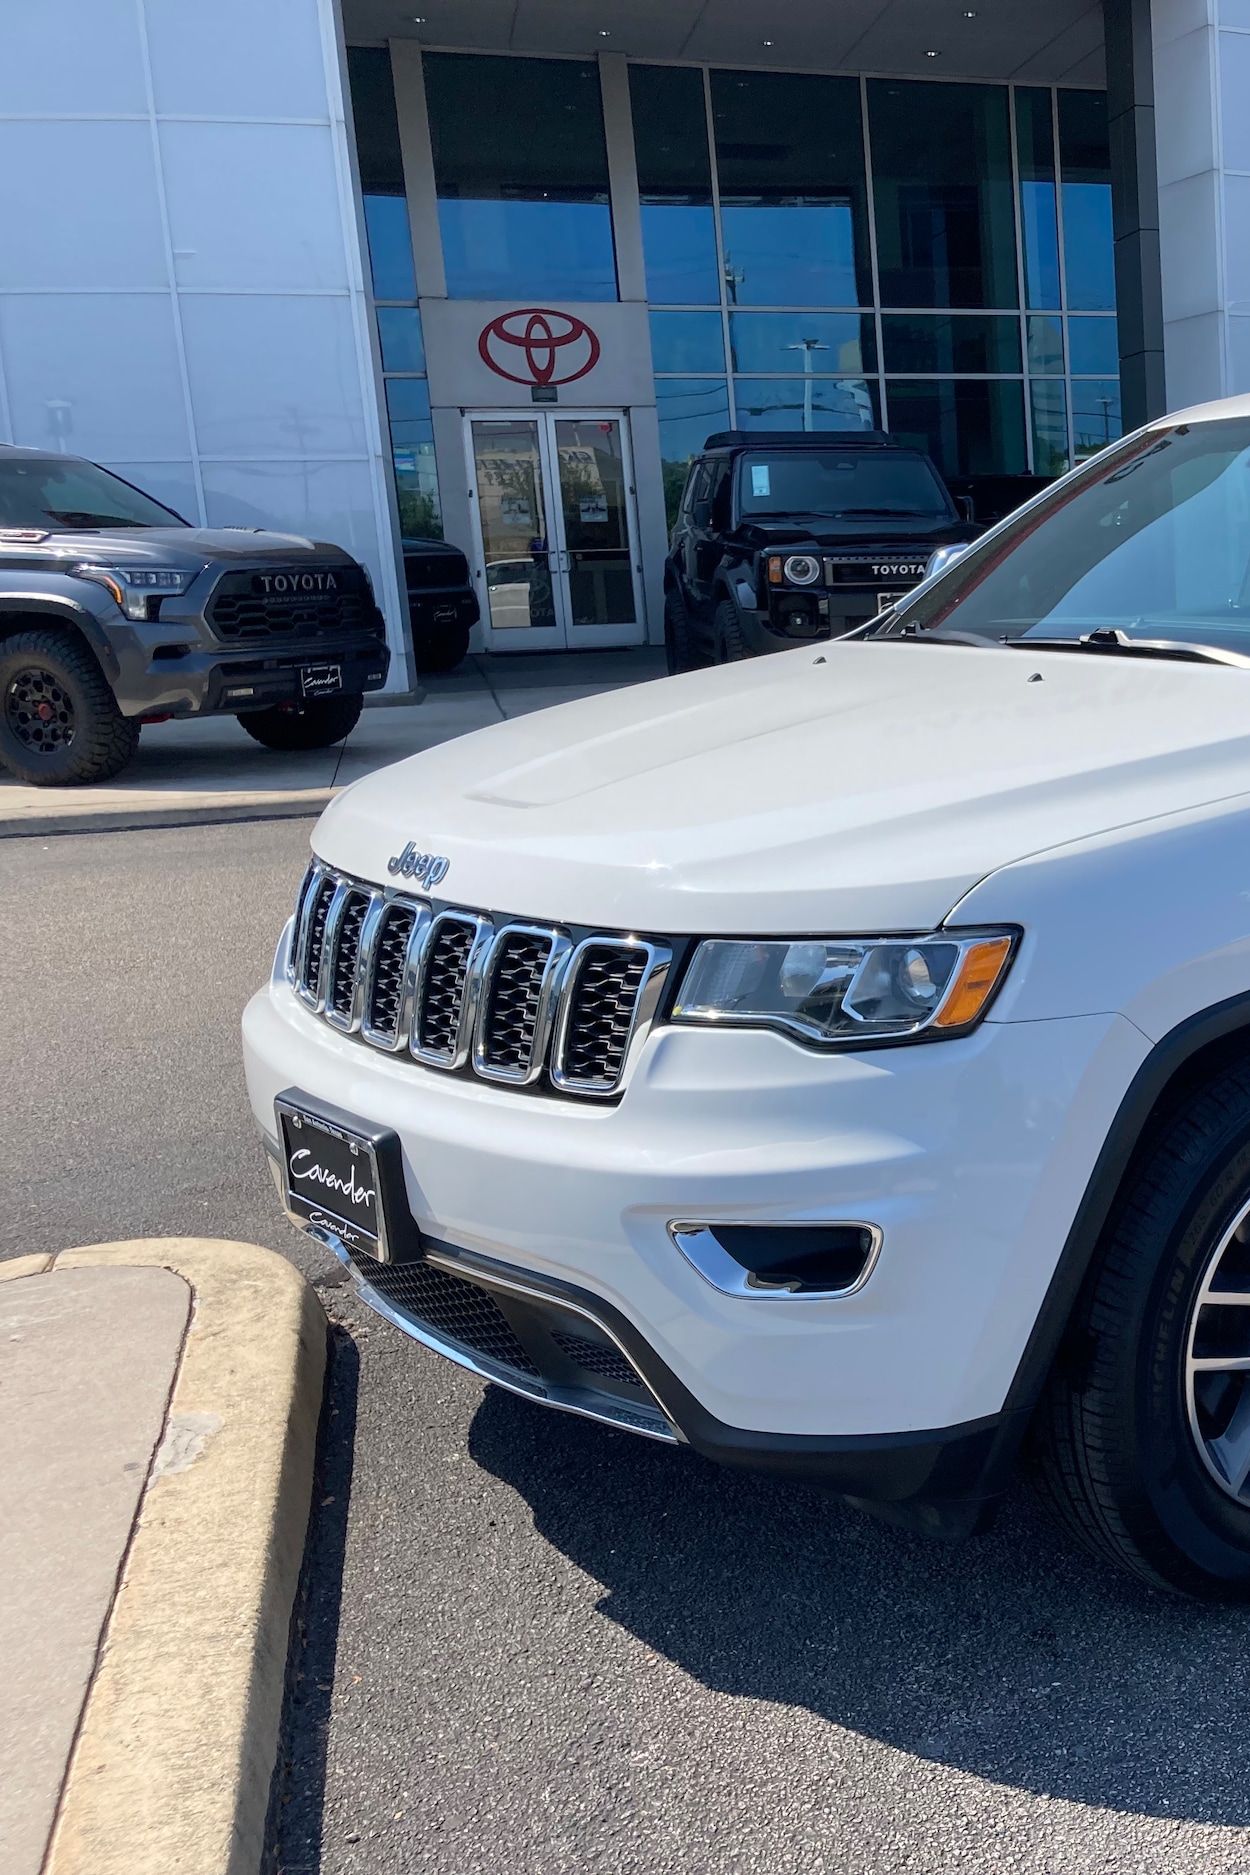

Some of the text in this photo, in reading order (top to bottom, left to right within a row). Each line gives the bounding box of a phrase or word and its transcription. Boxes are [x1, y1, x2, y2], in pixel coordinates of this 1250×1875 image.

[260, 572, 337, 593] TOYOTA
[871, 564, 925, 575] TOYOTA
[387, 840, 450, 891] Jeep
[290, 1148, 376, 1208] Cavender
[309, 1211, 360, 1242] Cavender
